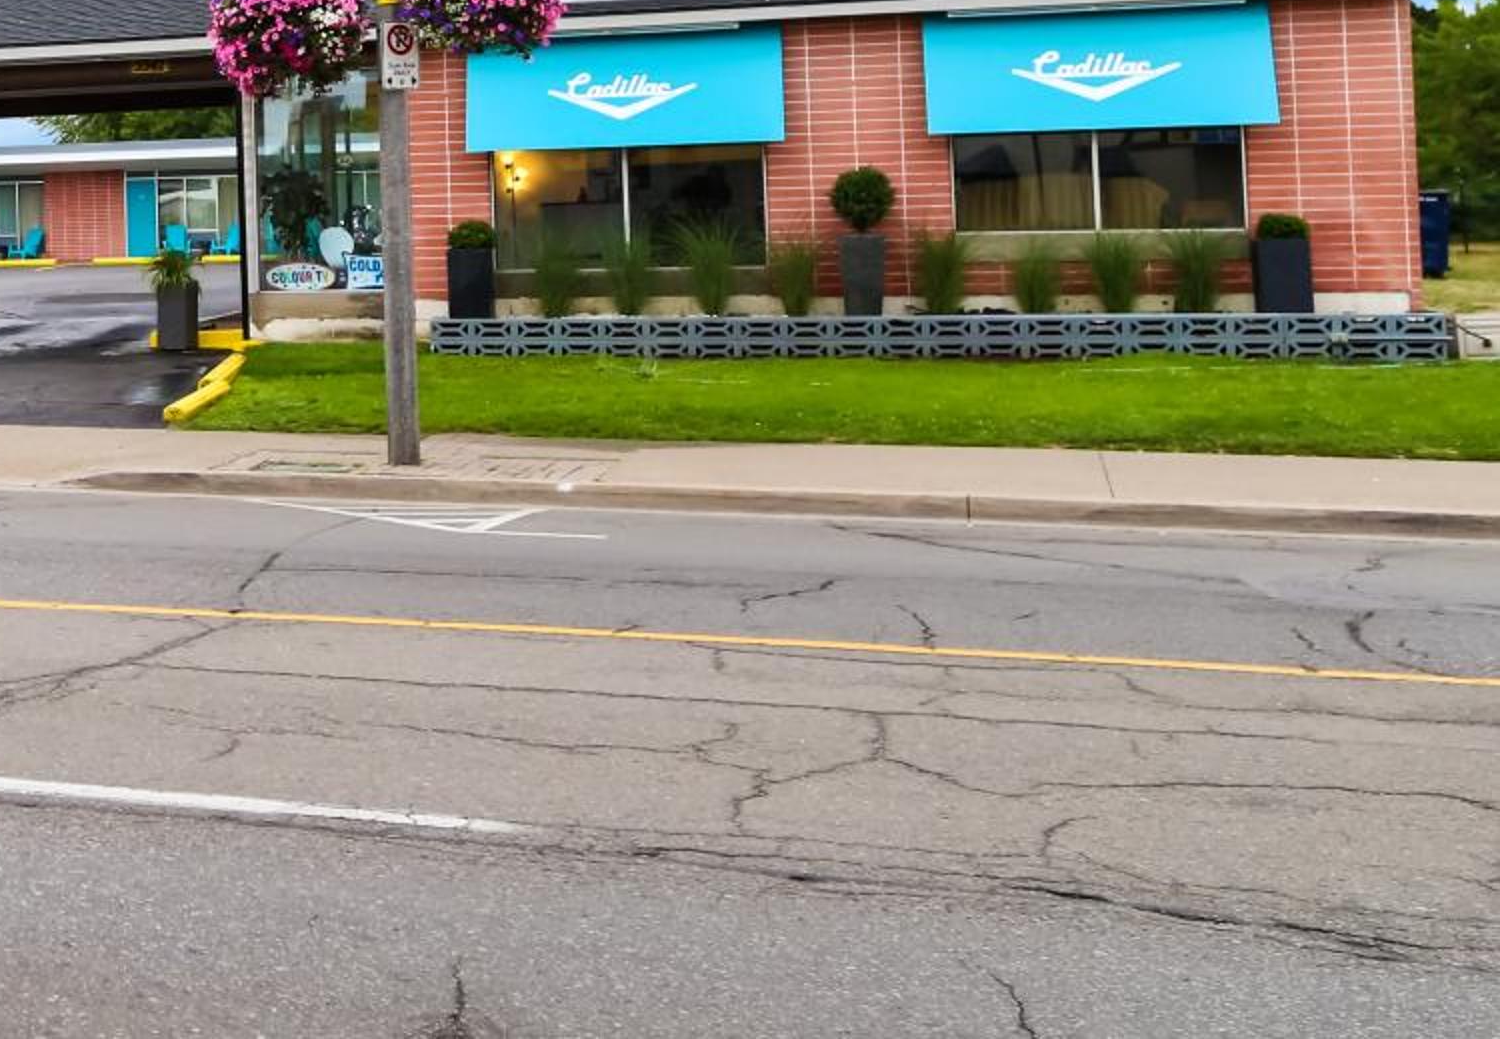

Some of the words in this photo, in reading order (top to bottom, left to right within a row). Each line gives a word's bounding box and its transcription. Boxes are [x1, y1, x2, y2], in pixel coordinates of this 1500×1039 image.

[1033, 50, 1155, 78] Cadillac
[566, 72, 674, 98] Cadillac
[349, 259, 381, 272] COLD
[271, 270, 313, 284] COLOUR
